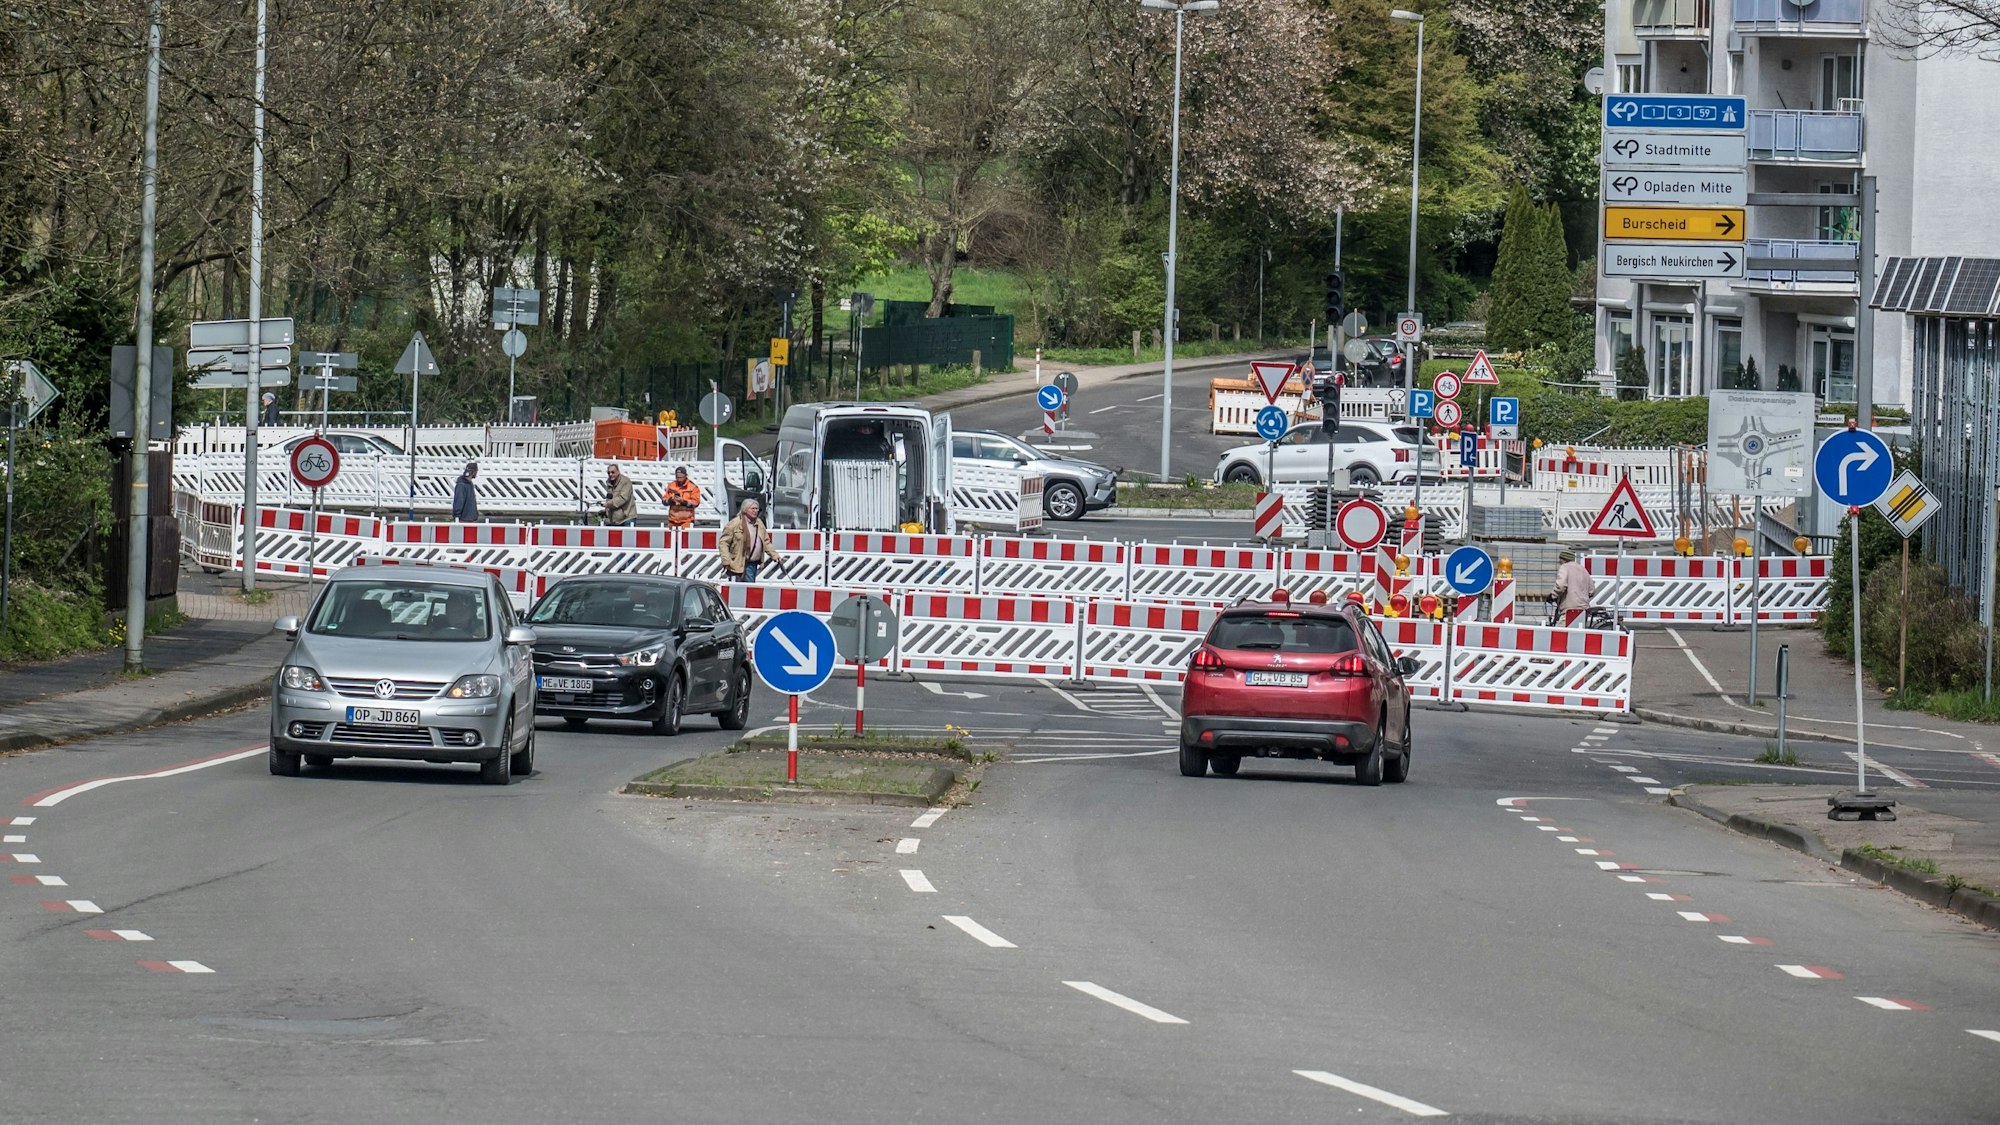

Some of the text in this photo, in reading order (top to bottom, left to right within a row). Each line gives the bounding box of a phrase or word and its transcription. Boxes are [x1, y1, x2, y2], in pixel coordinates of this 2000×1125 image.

[1676, 108, 1683, 118] 3
[1699, 108, 1710, 118] 59
[1645, 143, 1711, 156] Stadtmitte
[1644, 181, 1732, 195] Opladen Mitte
[1622, 217, 1686, 230] Burscheid
[1616, 255, 1713, 269] Bergisch Neukirchen
[1404, 323, 1414, 332] 30
[1414, 393, 1428, 414] P
[1728, 395, 1797, 405] Dosierungsanlage
[1497, 401, 1512, 422] P
[1464, 436, 1473, 461] P
[542, 678, 592, 689] ME VE 1805
[1253, 673, 1303, 683] GL VB 85
[355, 709, 417, 723] OP JD 866
